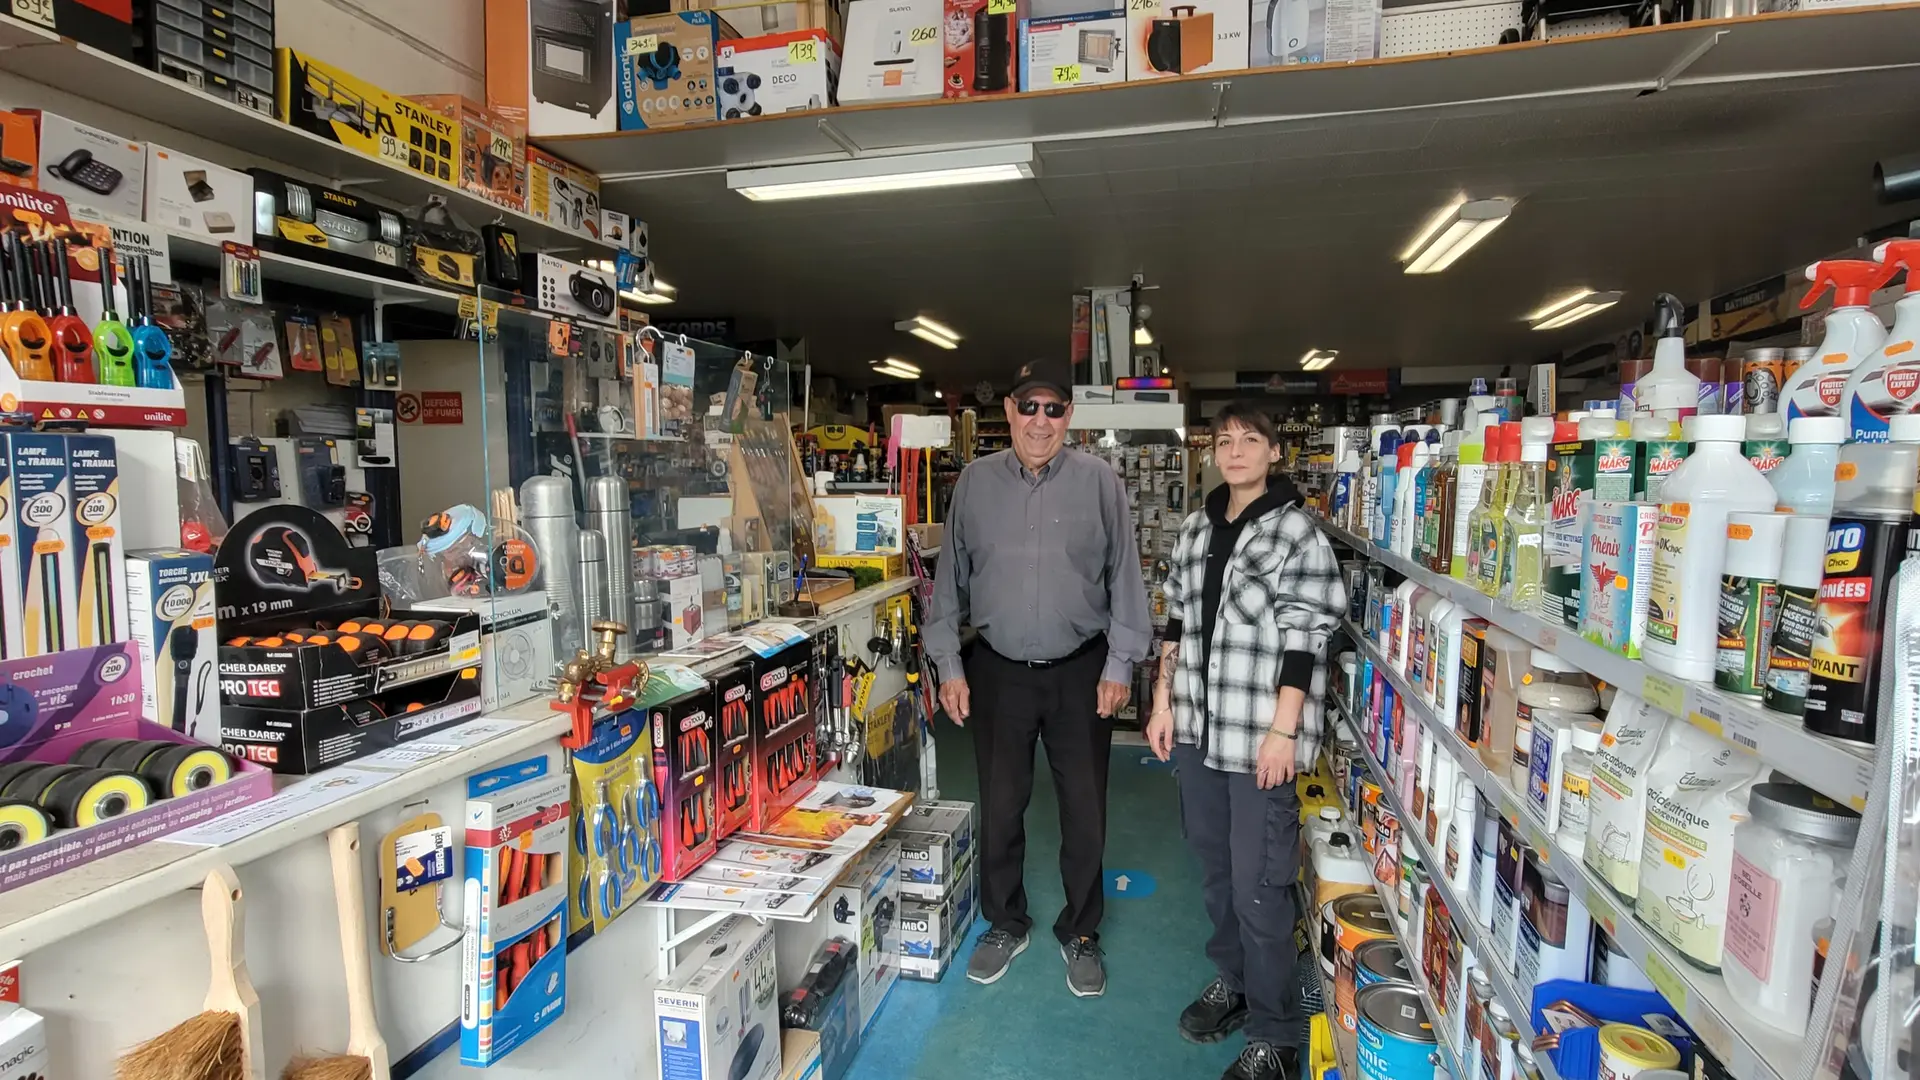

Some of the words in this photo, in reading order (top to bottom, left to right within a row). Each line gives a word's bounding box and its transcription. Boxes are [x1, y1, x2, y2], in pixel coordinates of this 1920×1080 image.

[1217, 33, 1228, 41] 3.3
[1229, 31, 1241, 39] KW
[772, 74, 797, 85] DECO
[395, 102, 452, 137] STANLEY
[323, 191, 357, 208] STANLEY
[541, 257, 565, 269] PLAYBOX
[1890, 373, 1918, 383] PROTECT
[1891, 381, 1915, 390] EXPERT
[424, 398, 460, 408] DEFENSE
[144, 411, 173, 422] unilite
[423, 408, 435, 418] DE
[436, 407, 462, 418] FUMER
[826, 425, 844, 434] WD-40
[18, 447, 47, 456] LAMPE
[73, 449, 100, 458] LAMPE
[28, 457, 65, 467] TRAVAIL
[82, 459, 116, 468] TRAVAIL
[1599, 455, 1631, 471] MARC
[1650, 457, 1683, 473] MARC
[1751, 456, 1785, 471] MARC
[32, 505, 53, 514] 300
[86, 504, 105, 514] 300
[1551, 489, 1582, 521] MARC
[1591, 533, 1621, 558] Phénix
[1828, 557, 1849, 568] Choc
[158, 567, 188, 578] TORCHE
[188, 572, 210, 584] XXL
[242, 606, 249, 615] x
[252, 601, 267, 614] 19
[270, 599, 293, 610] mm
[13, 665, 54, 680] crochet
[105, 663, 122, 674] 200
[41, 684, 78, 696] encoches
[50, 694, 67, 705] vis
[110, 692, 136, 706] 1h30
[704, 715, 713, 731] x6
[1596, 747, 1638, 778] percarbonate
[1651, 805, 1688, 830] concentré
[8, 858, 28, 874] pas
[98, 829, 116, 843] dans
[131, 812, 161, 832] endroits
[4, 870, 27, 885] mais
[28, 861, 52, 877] aussi
[94, 839, 123, 856] panne
[705, 914, 738, 946] SEVERIN
[744, 926, 775, 966] SEVERIN
[657, 996, 700, 1009] SEVERIN
